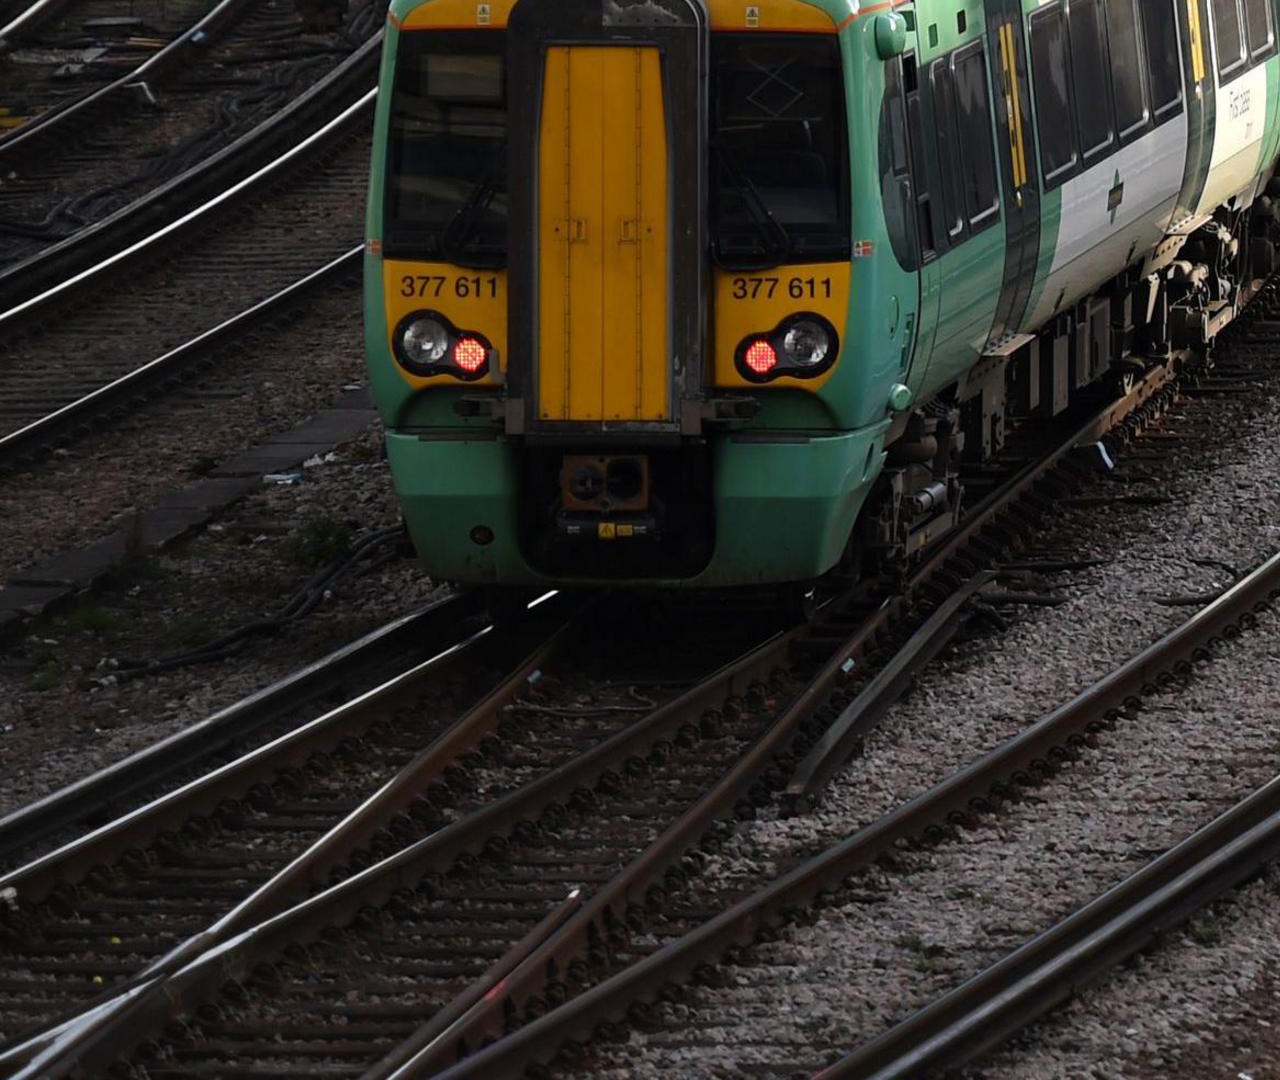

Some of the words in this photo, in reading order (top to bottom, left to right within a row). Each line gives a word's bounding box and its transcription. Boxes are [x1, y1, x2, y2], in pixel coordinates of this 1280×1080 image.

[401, 275, 447, 298] 377
[454, 276, 497, 298] 611
[732, 277, 779, 299] 377
[788, 277, 832, 299] 611
